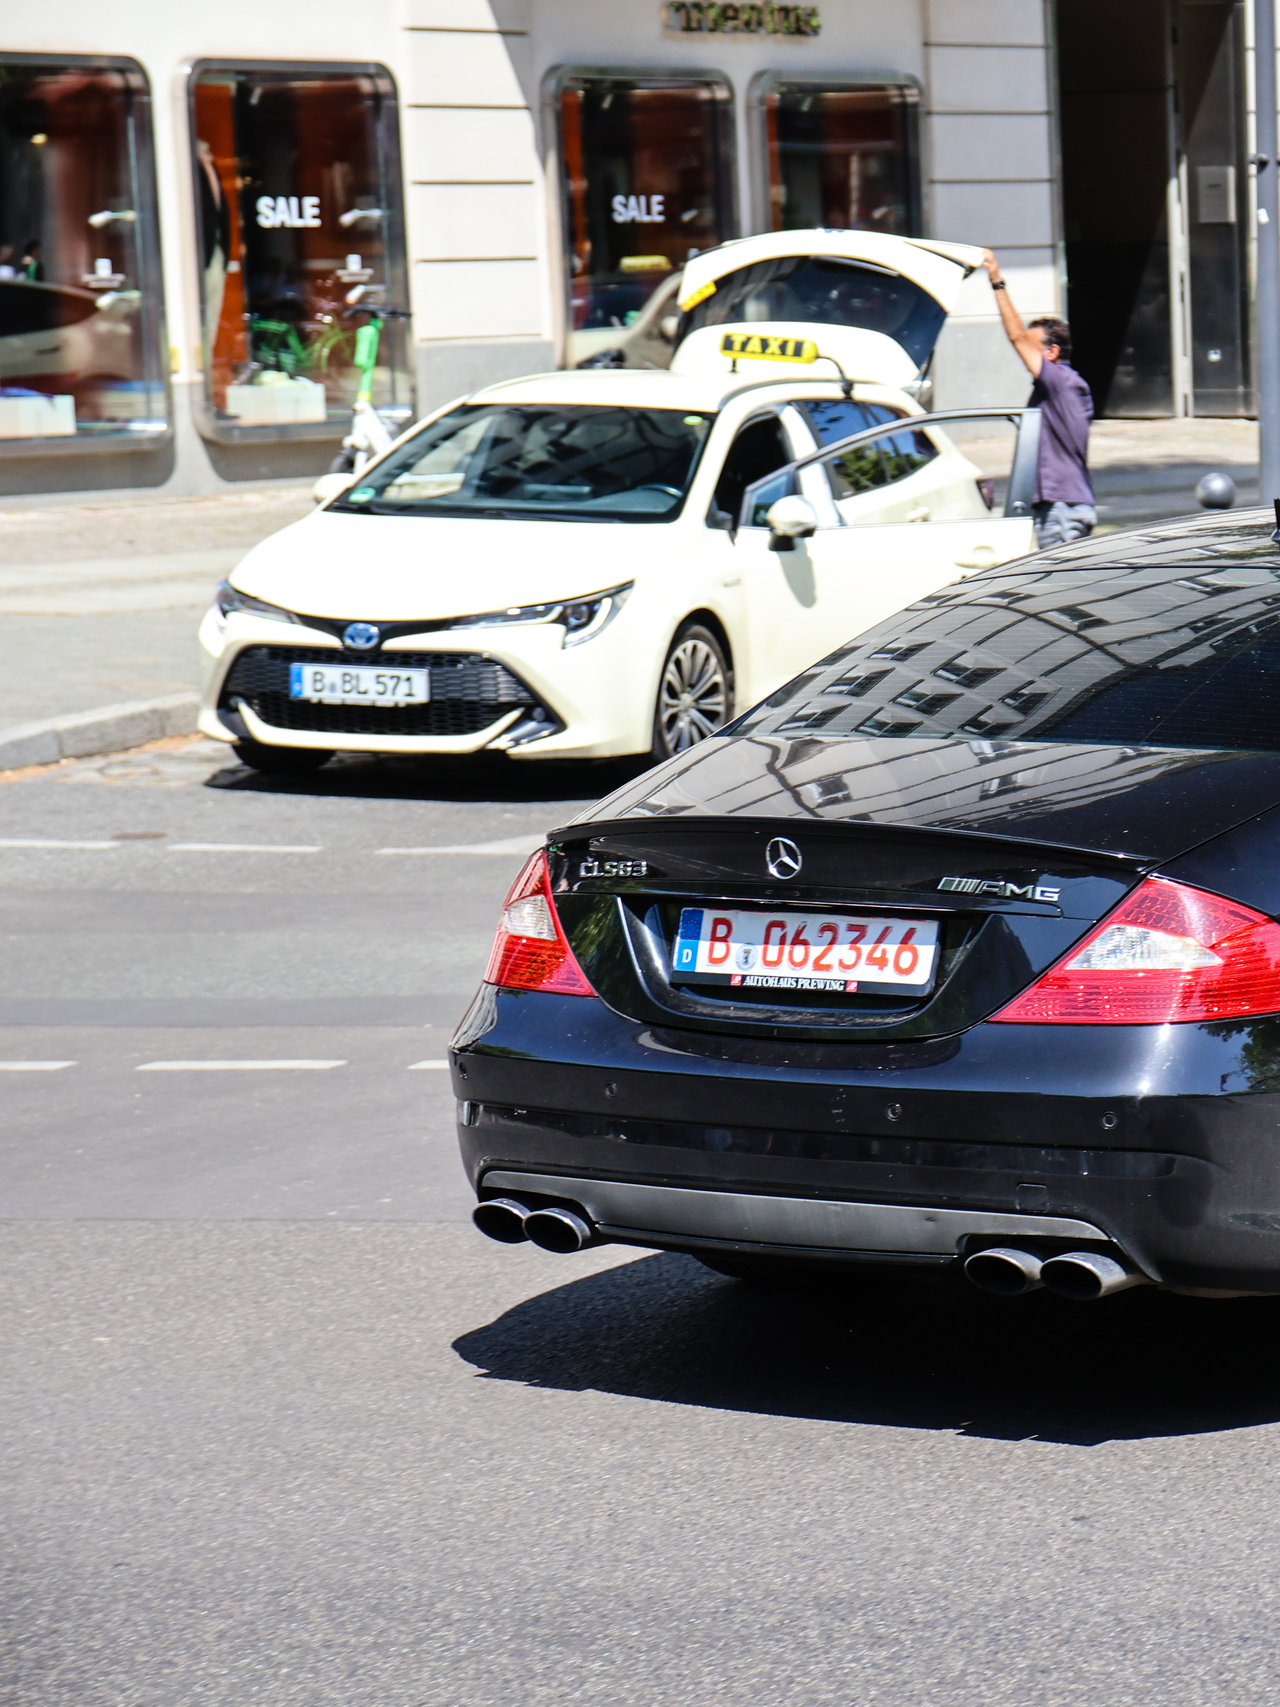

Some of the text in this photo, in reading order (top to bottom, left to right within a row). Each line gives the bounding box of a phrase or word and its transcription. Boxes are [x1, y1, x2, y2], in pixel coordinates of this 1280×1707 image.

[256, 196, 322, 228] SALE
[612, 194, 666, 223] SALE
[730, 335, 796, 356] TAXI
[312, 671, 325, 692] B
[375, 675, 416, 697] 571
[579, 860, 648, 878] CLS63
[976, 880, 1061, 901] AMG
[707, 917, 919, 976] B 062346
[743, 975, 797, 988] AUTOHAUS
[797, 978, 845, 991] PREWING
